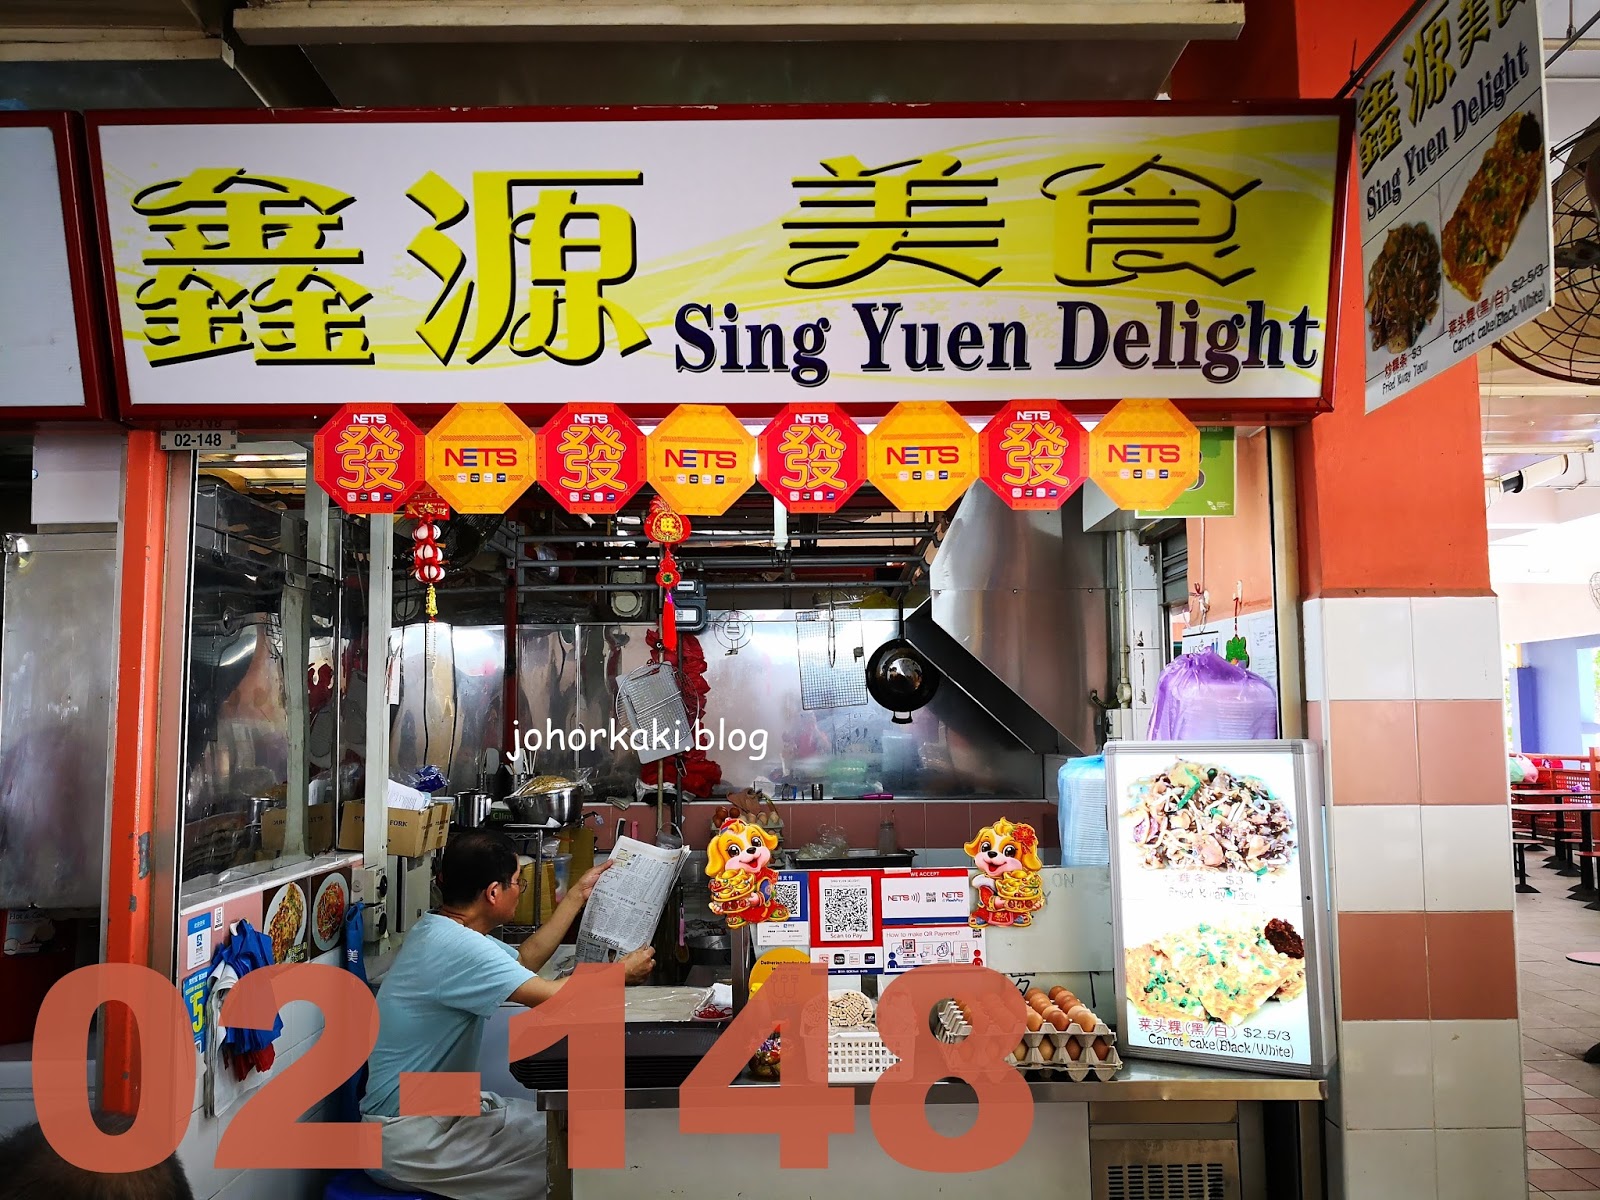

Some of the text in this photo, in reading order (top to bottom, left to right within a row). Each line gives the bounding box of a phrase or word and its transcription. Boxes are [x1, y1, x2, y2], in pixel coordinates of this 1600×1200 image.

[1366, 41, 1529, 222] Sing Yuen Delight
[674, 299, 1320, 387] Sing Yuen Delight
[1453, 331, 1475, 353] Carrot
[353, 413, 387, 424] NETS
[574, 413, 608, 424] NETS
[795, 413, 829, 424] NETS
[1016, 411, 1050, 421] NETS
[174, 433, 222, 447] 02-148
[445, 448, 517, 467] NETS
[665, 449, 737, 469] NETS
[887, 446, 959, 465] NETS
[1108, 444, 1180, 463] NETS
[389, 819, 408, 828] FORK
[1148, 1033, 1184, 1047] Carrot
[1243, 1027, 1291, 1041] $2.5/3
